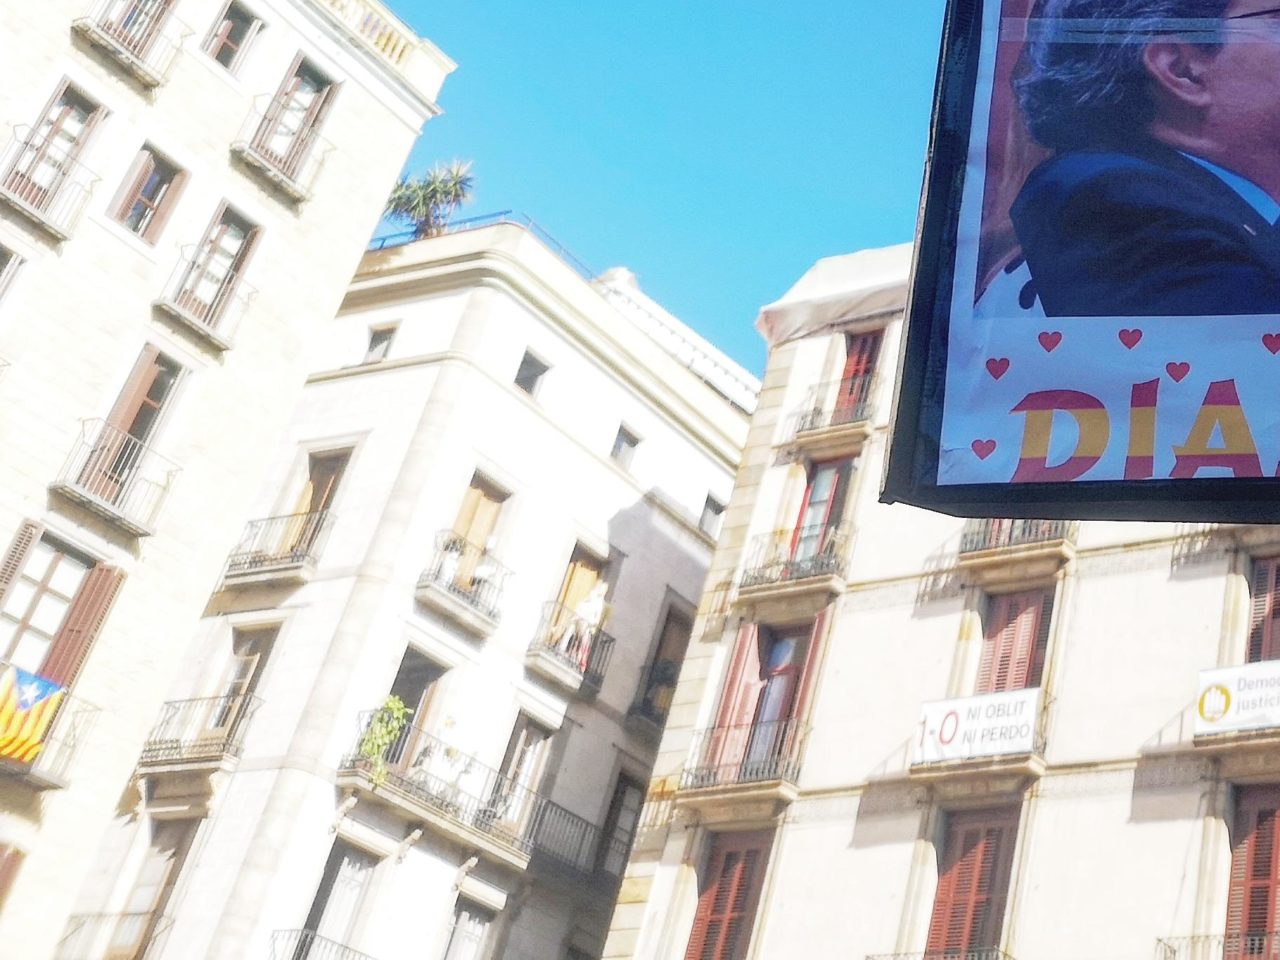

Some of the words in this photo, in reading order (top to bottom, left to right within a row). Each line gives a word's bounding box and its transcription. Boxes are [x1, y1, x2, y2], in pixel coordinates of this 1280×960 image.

[966, 704, 982, 721] NI
[985, 700, 1027, 719] OBLIT
[961, 727, 978, 744] NI
